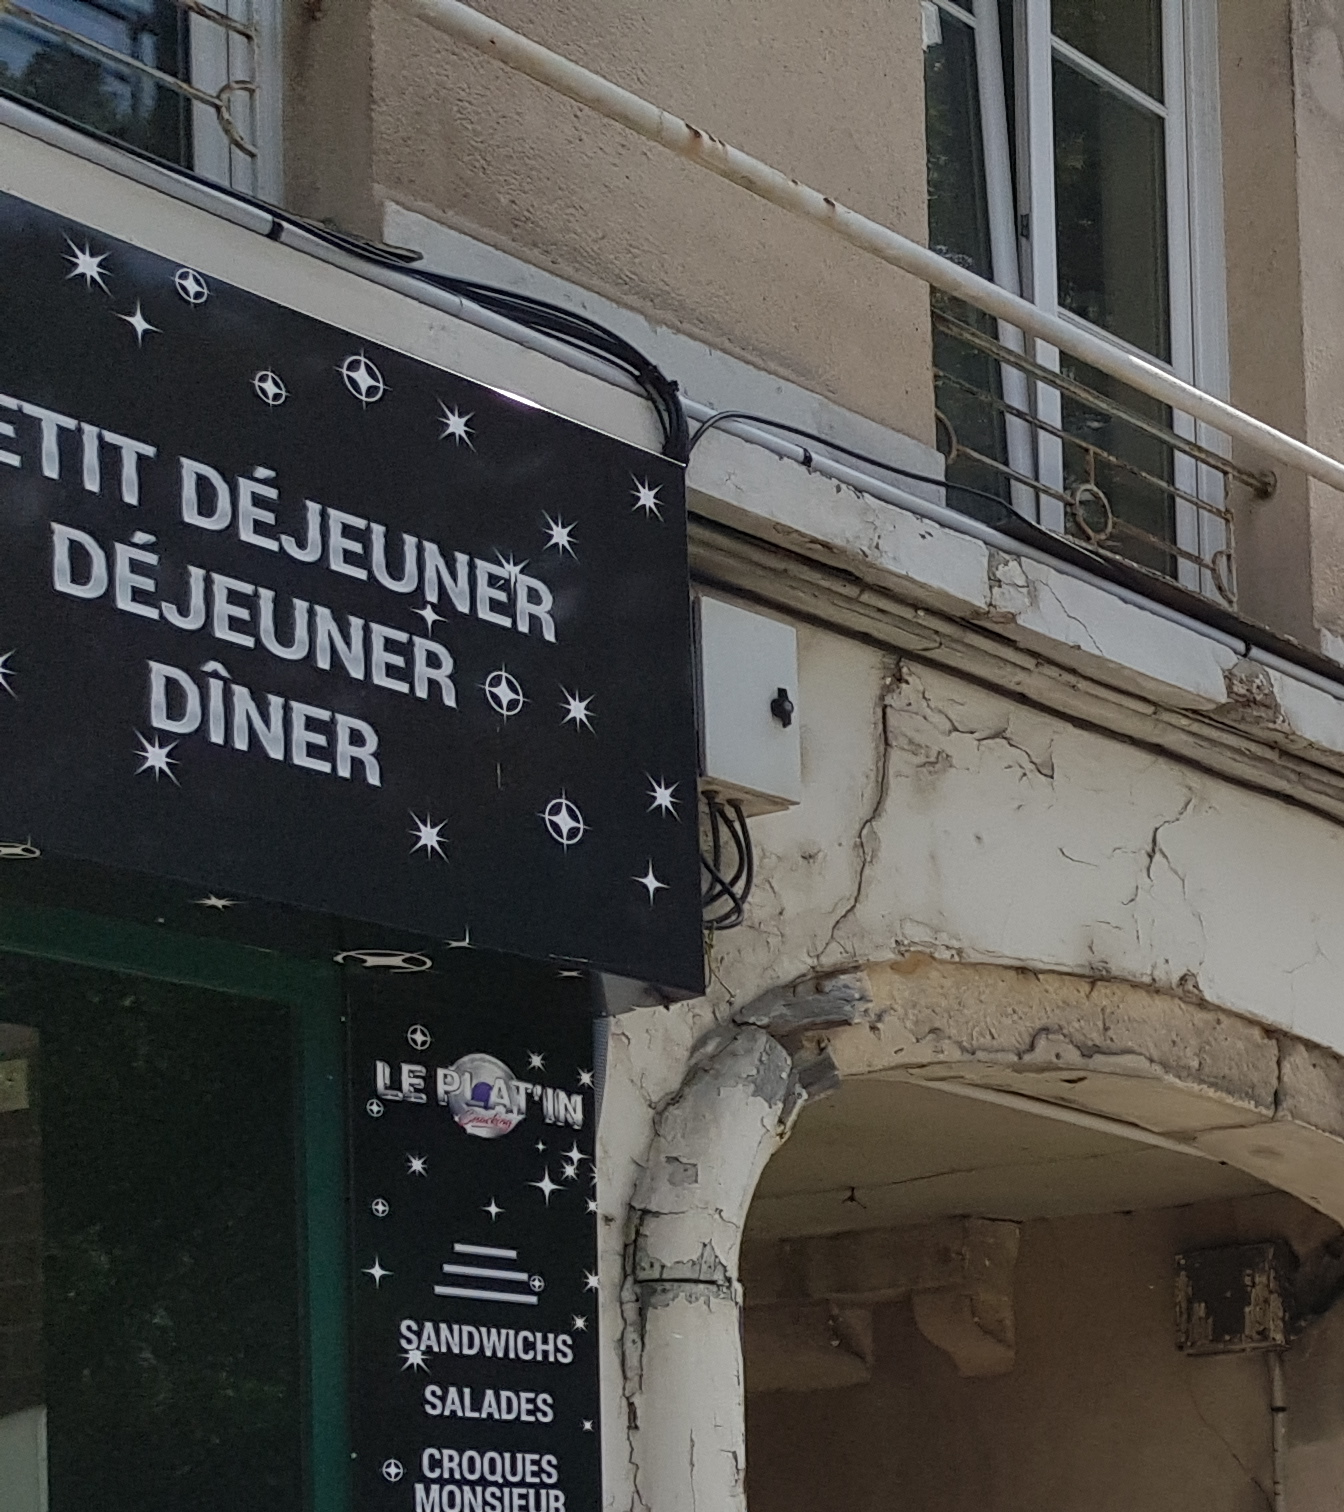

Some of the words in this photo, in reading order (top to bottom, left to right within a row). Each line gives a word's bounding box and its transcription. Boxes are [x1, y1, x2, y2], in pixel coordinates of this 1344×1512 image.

[179, 456, 556, 642] DÉJEUNER
[50, 520, 459, 709] DÉJEUNER
[147, 660, 382, 788] DÎNER
[375, 1059, 427, 1104] LE
[400, 1319, 574, 1364] SANDWICHS
[424, 1384, 555, 1424] SALADES
[421, 1447, 559, 1484] CROQUES
